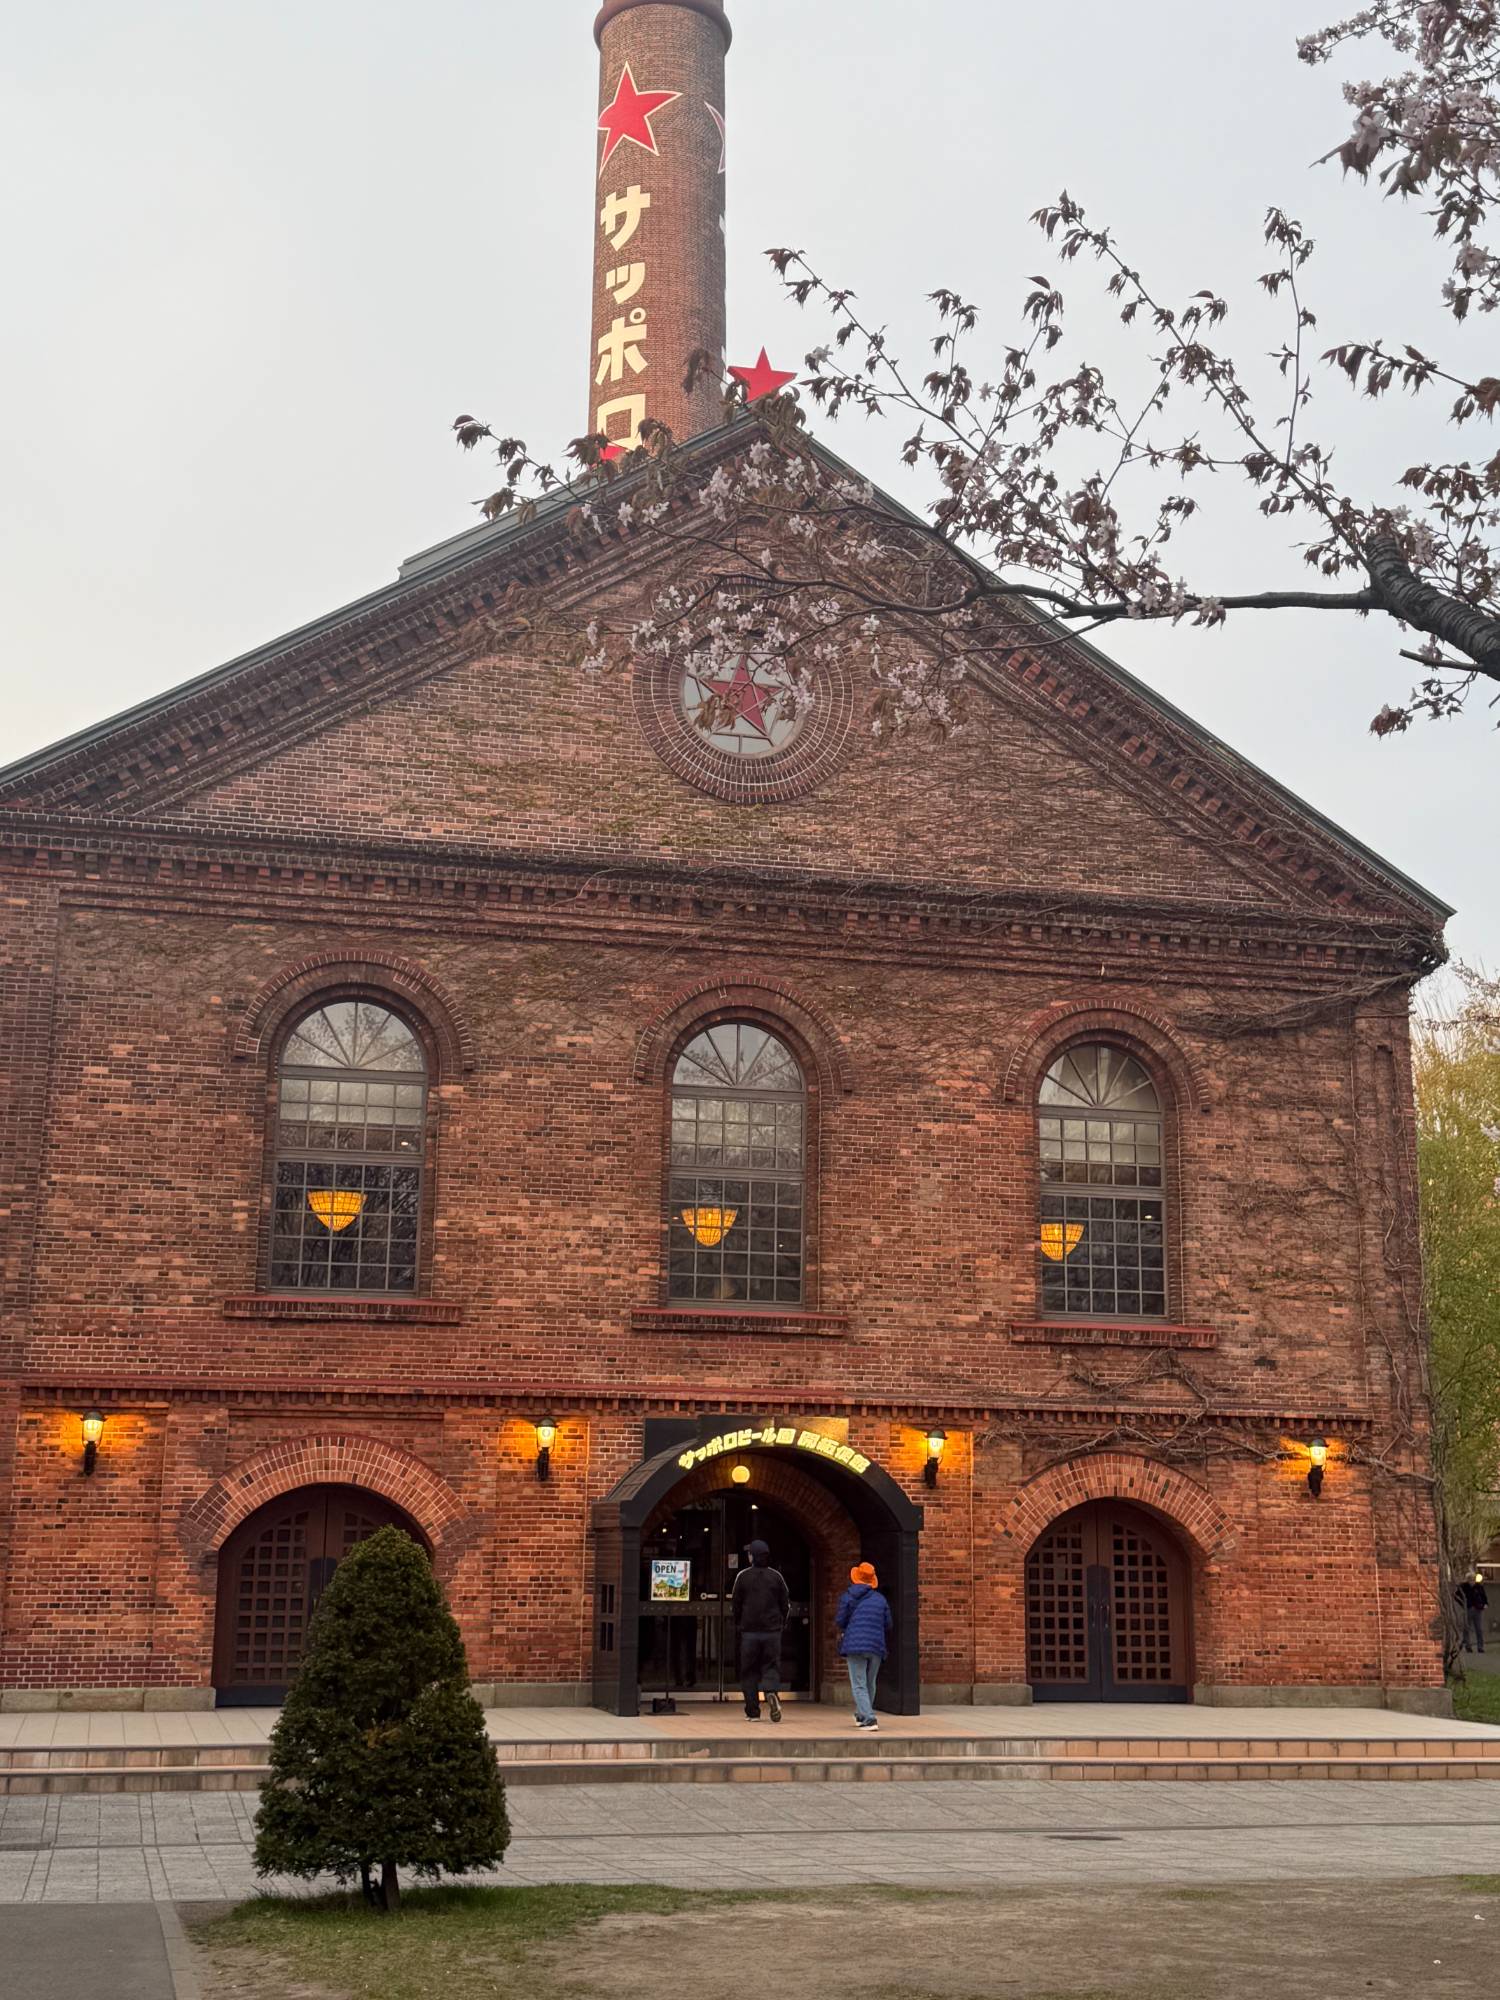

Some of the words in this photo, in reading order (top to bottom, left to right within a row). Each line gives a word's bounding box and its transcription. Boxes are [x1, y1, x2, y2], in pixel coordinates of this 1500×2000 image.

[595, 184, 651, 451] サッポロ
[655, 1564, 677, 1574] OPEN
